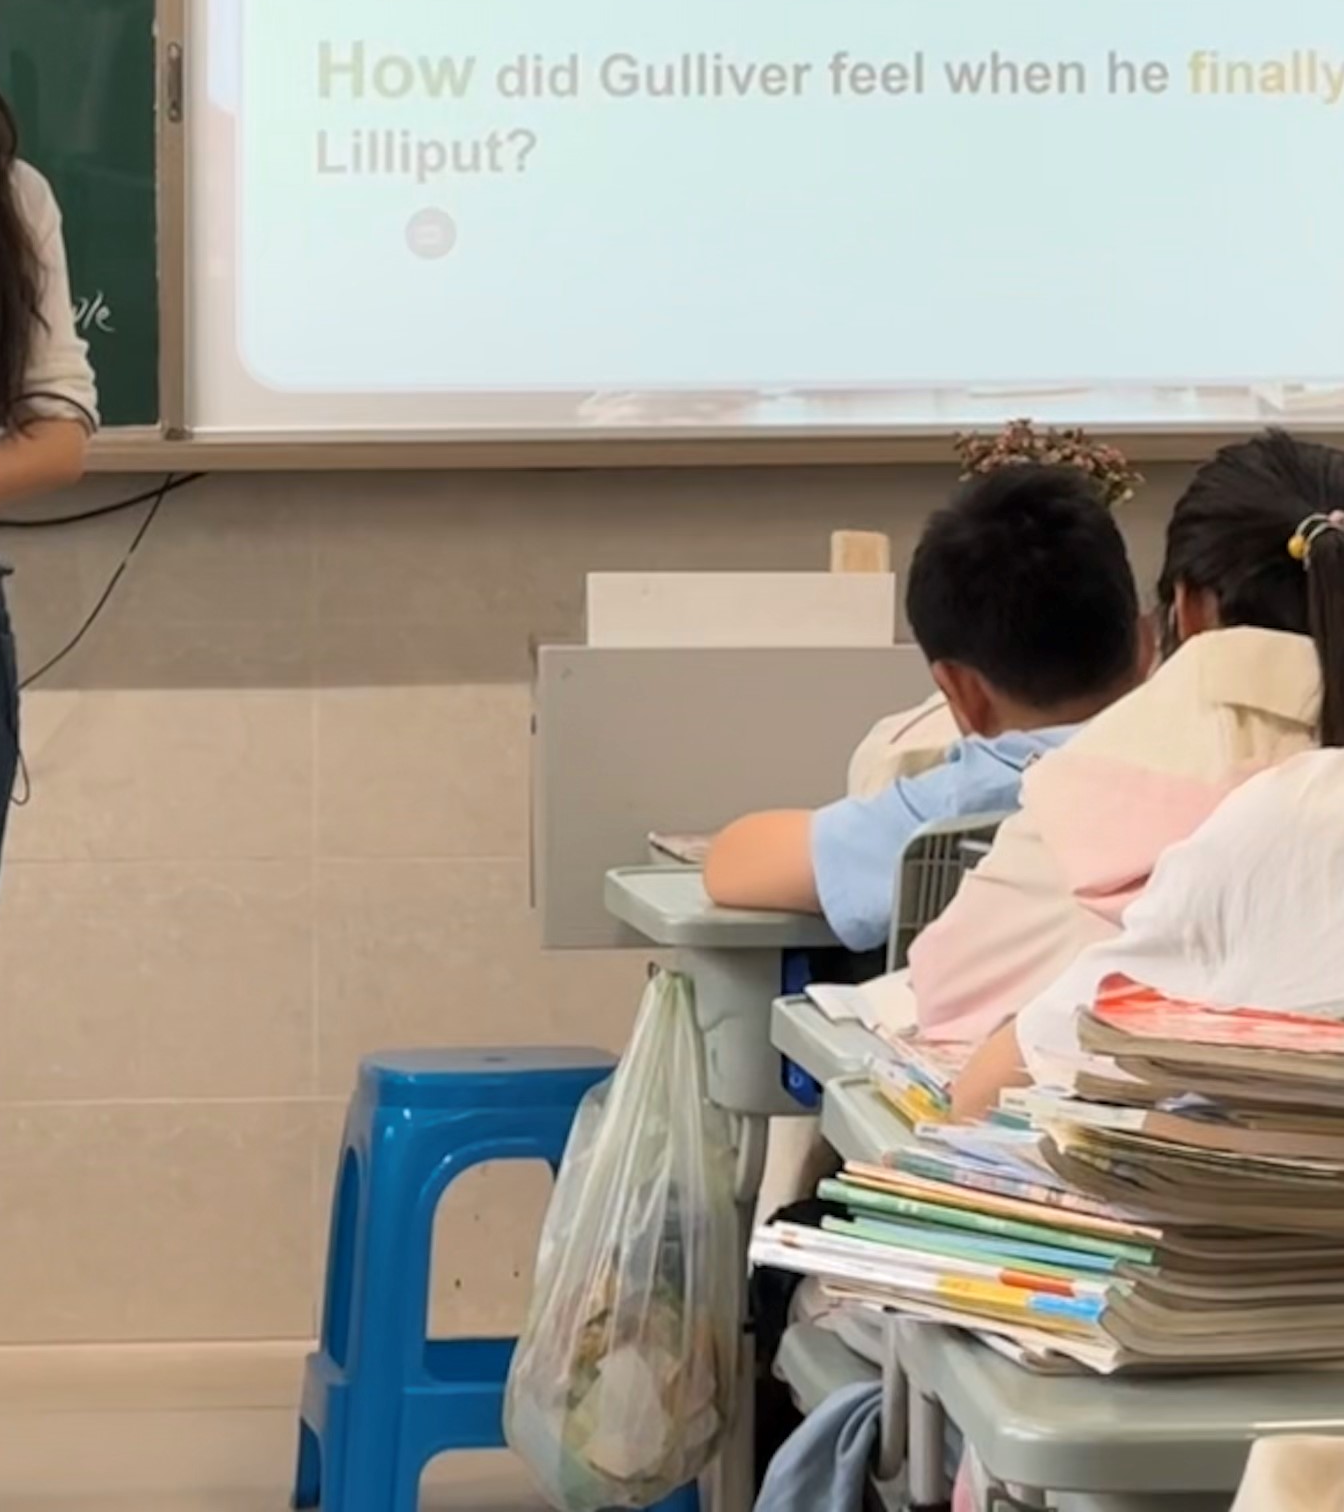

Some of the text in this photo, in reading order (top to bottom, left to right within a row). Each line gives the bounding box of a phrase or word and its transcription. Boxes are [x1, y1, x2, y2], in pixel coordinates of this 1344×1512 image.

[317, 40, 477, 99] How
[496, 53, 579, 98] did
[599, 51, 812, 98] Gulliver
[828, 50, 925, 97] feel
[943, 50, 1087, 94] when
[1106, 50, 1169, 94] he
[316, 127, 538, 184] Lilliput?
